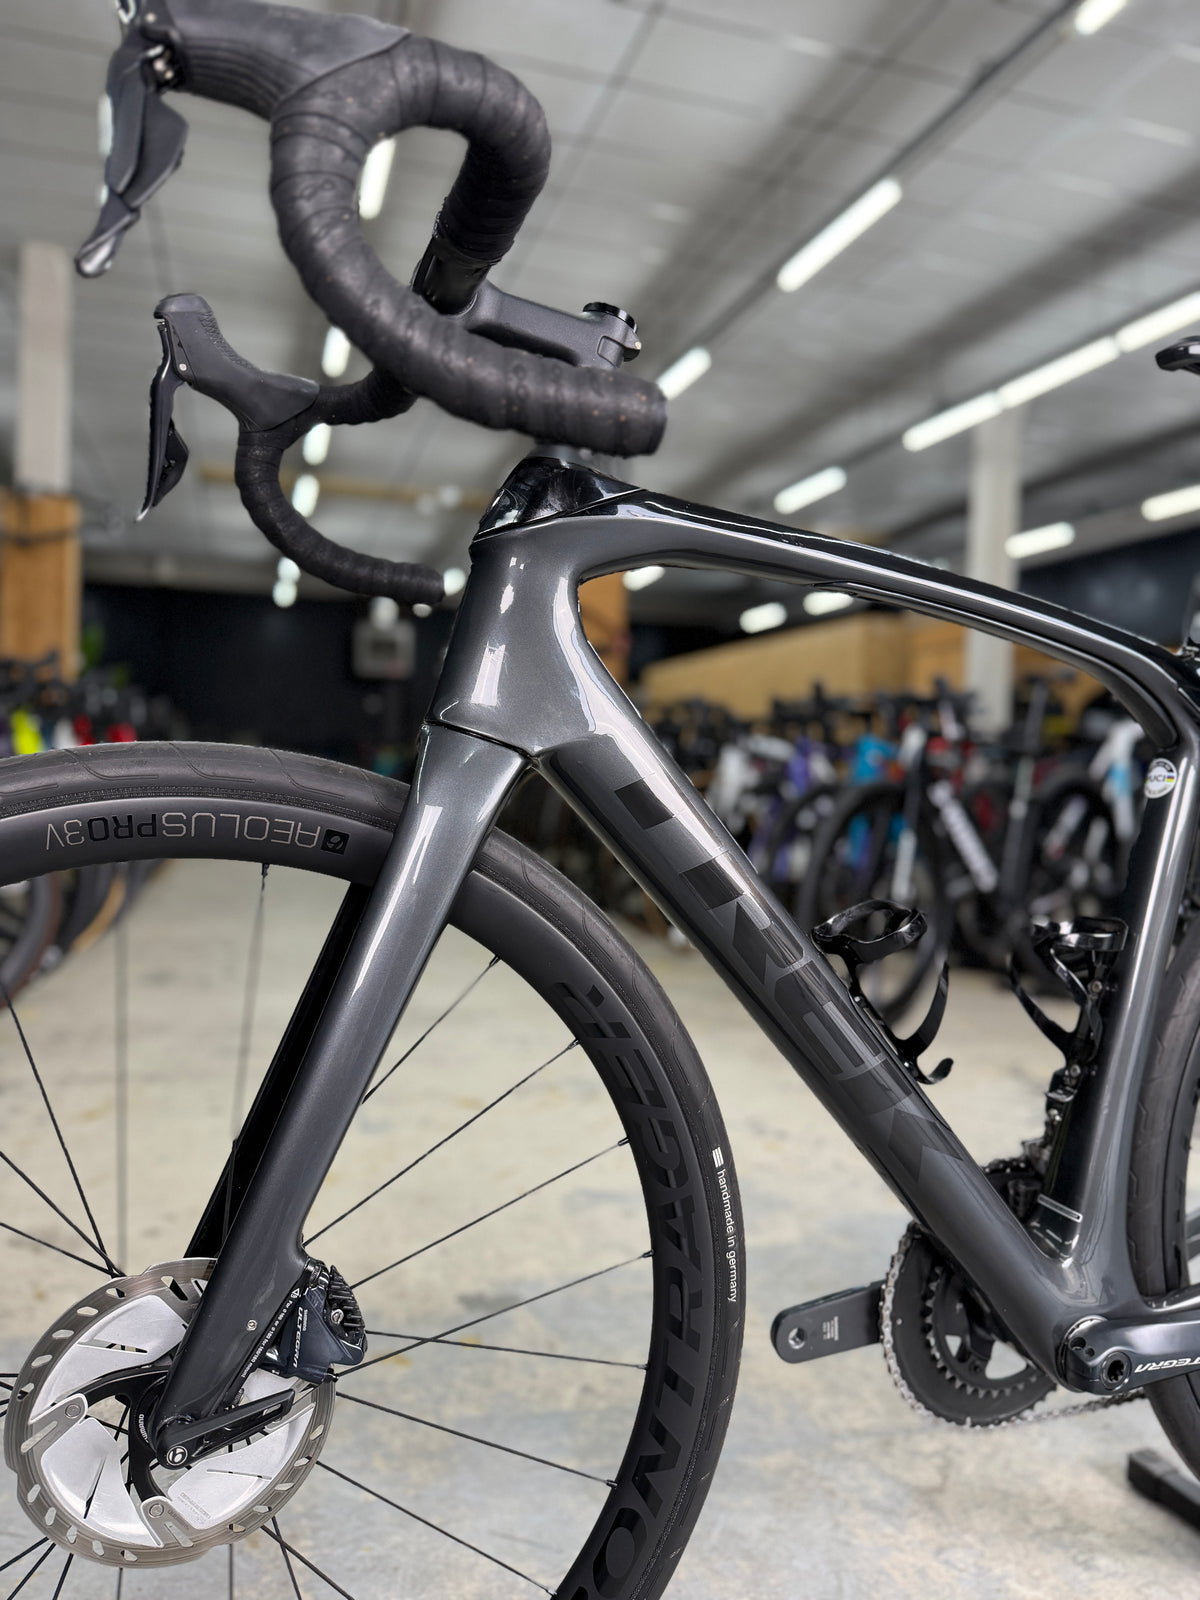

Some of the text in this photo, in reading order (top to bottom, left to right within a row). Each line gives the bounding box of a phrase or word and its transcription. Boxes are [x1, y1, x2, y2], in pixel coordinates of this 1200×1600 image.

[615, 725, 963, 1183] TREK
[293, 1307, 303, 1368] ULTEGRA
[553, 982, 702, 1600] ONTRAGER
[717, 1169, 736, 1302] handmade in germany
